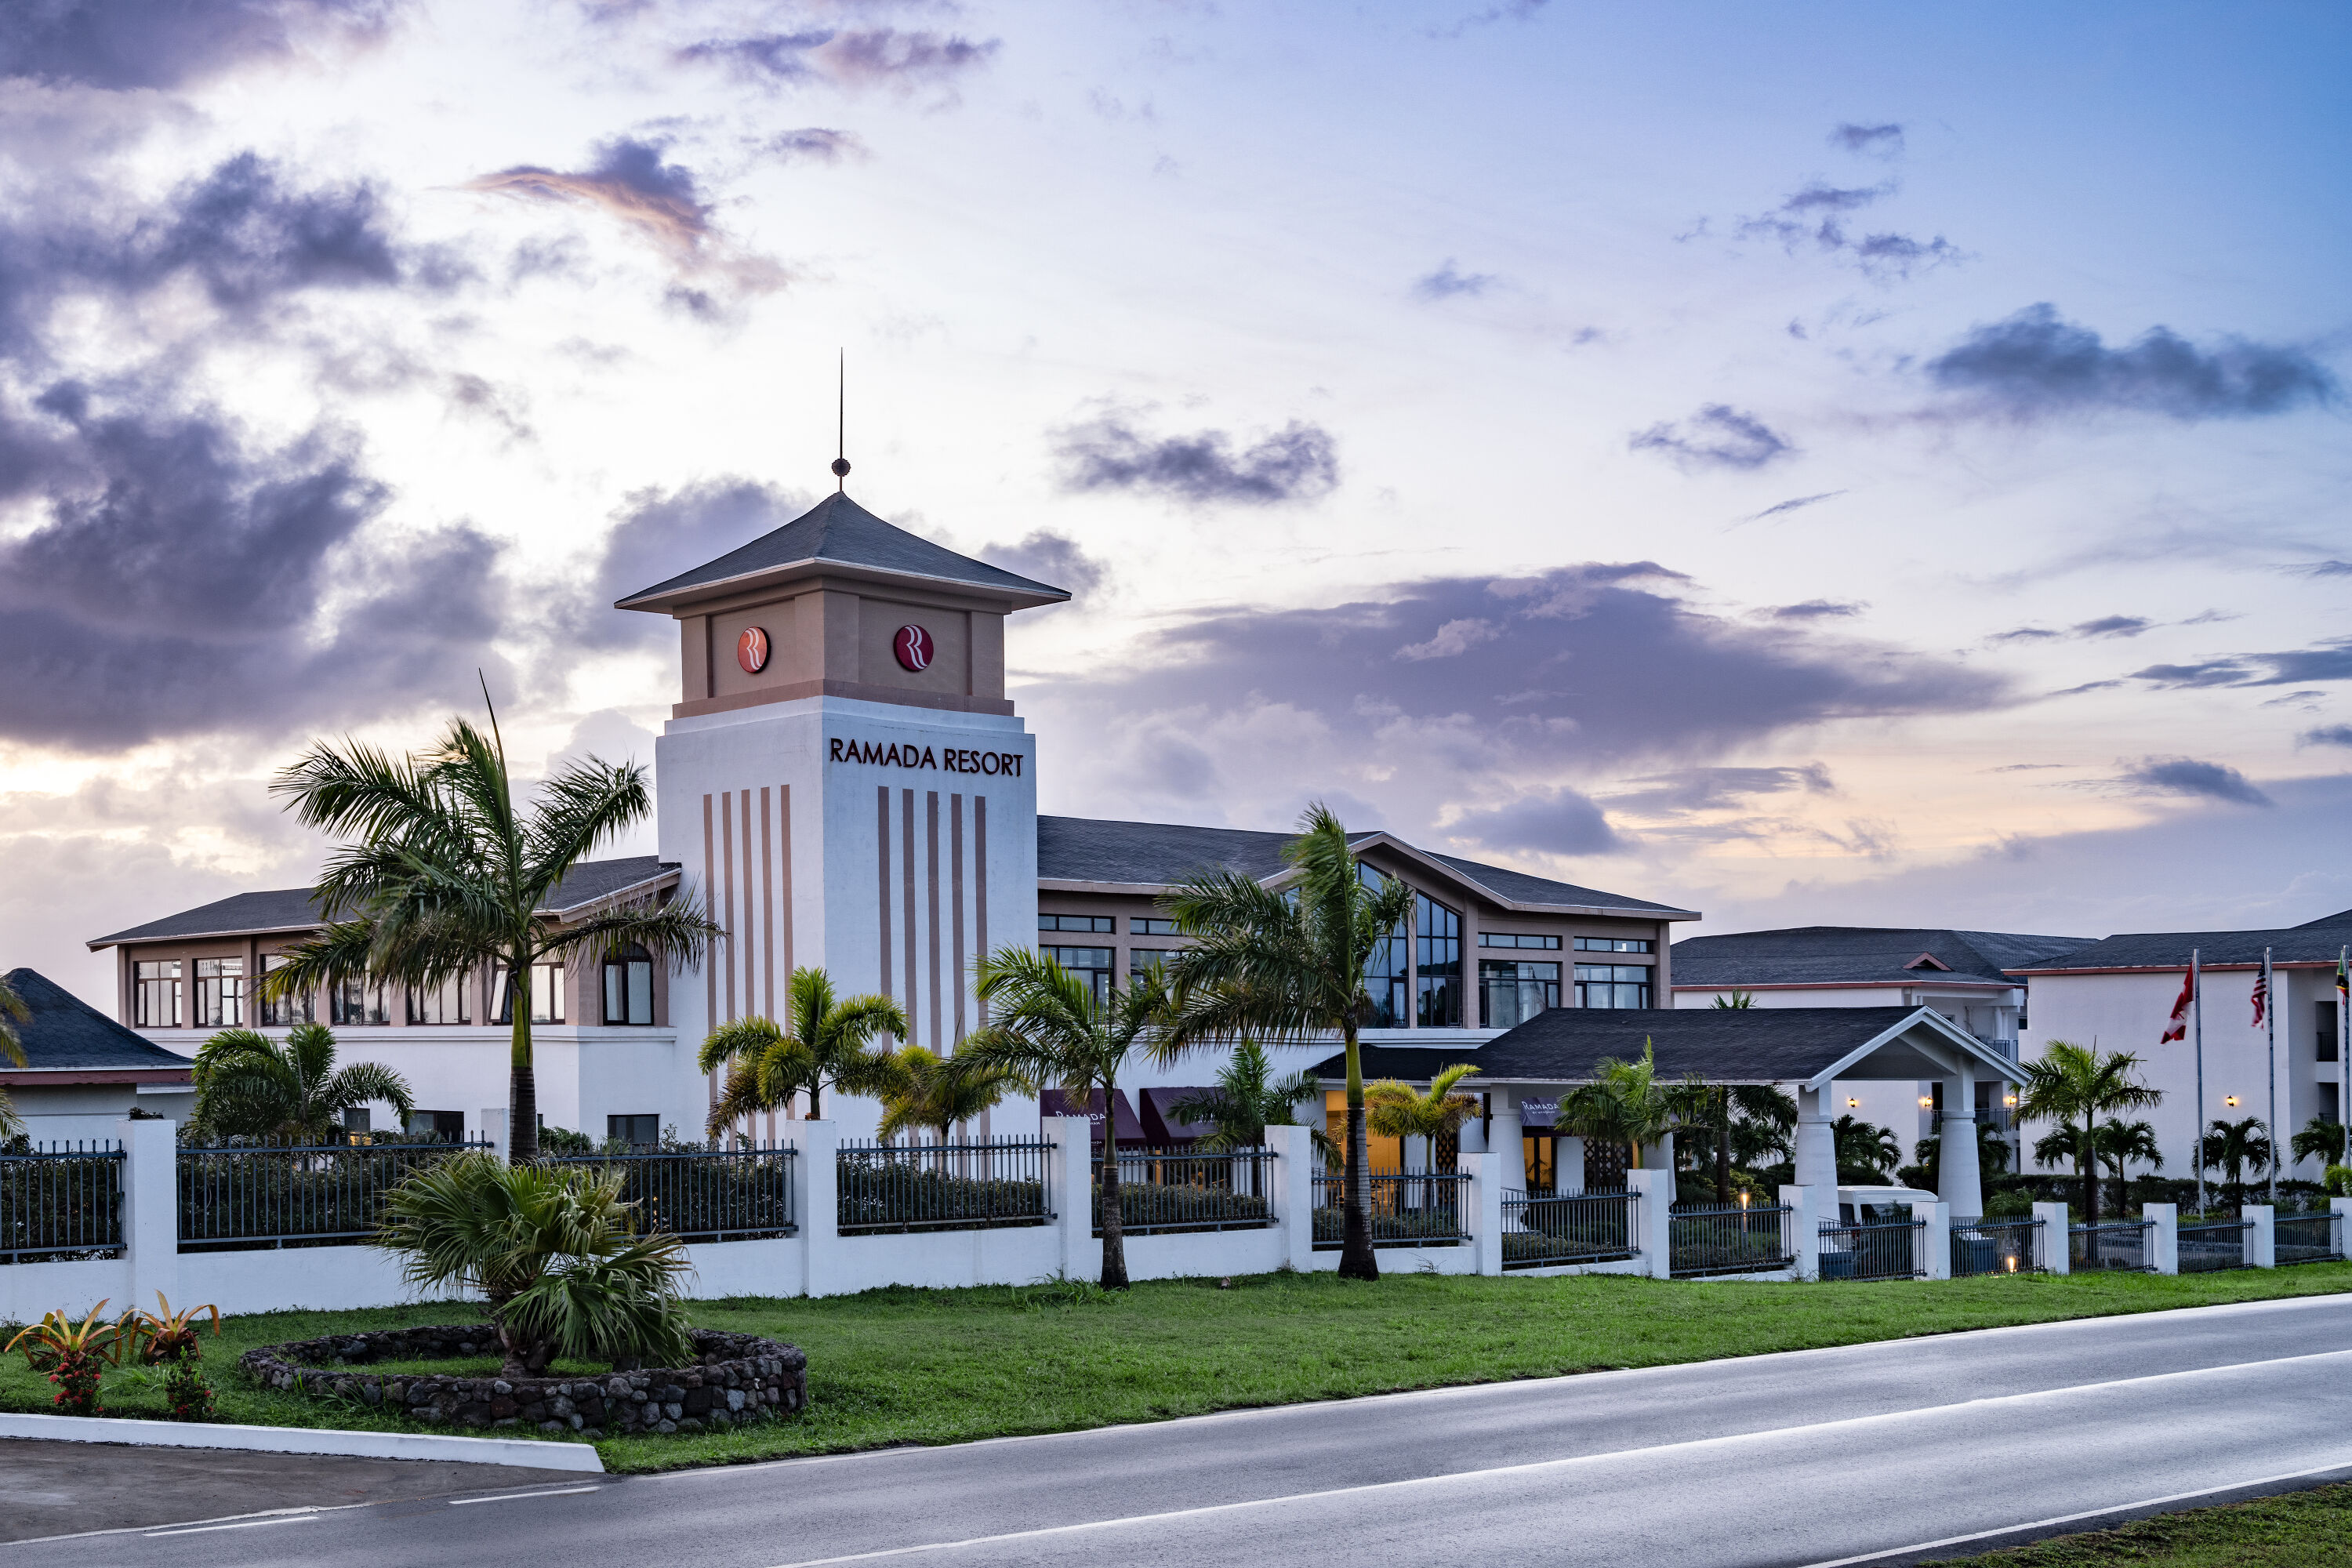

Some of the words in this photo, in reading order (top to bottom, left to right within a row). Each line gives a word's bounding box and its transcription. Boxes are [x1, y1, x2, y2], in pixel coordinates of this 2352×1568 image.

[829, 737, 938, 770] RAMADA
[944, 748, 1024, 777] RESORT
[1521, 1101, 1560, 1110] RAMADA
